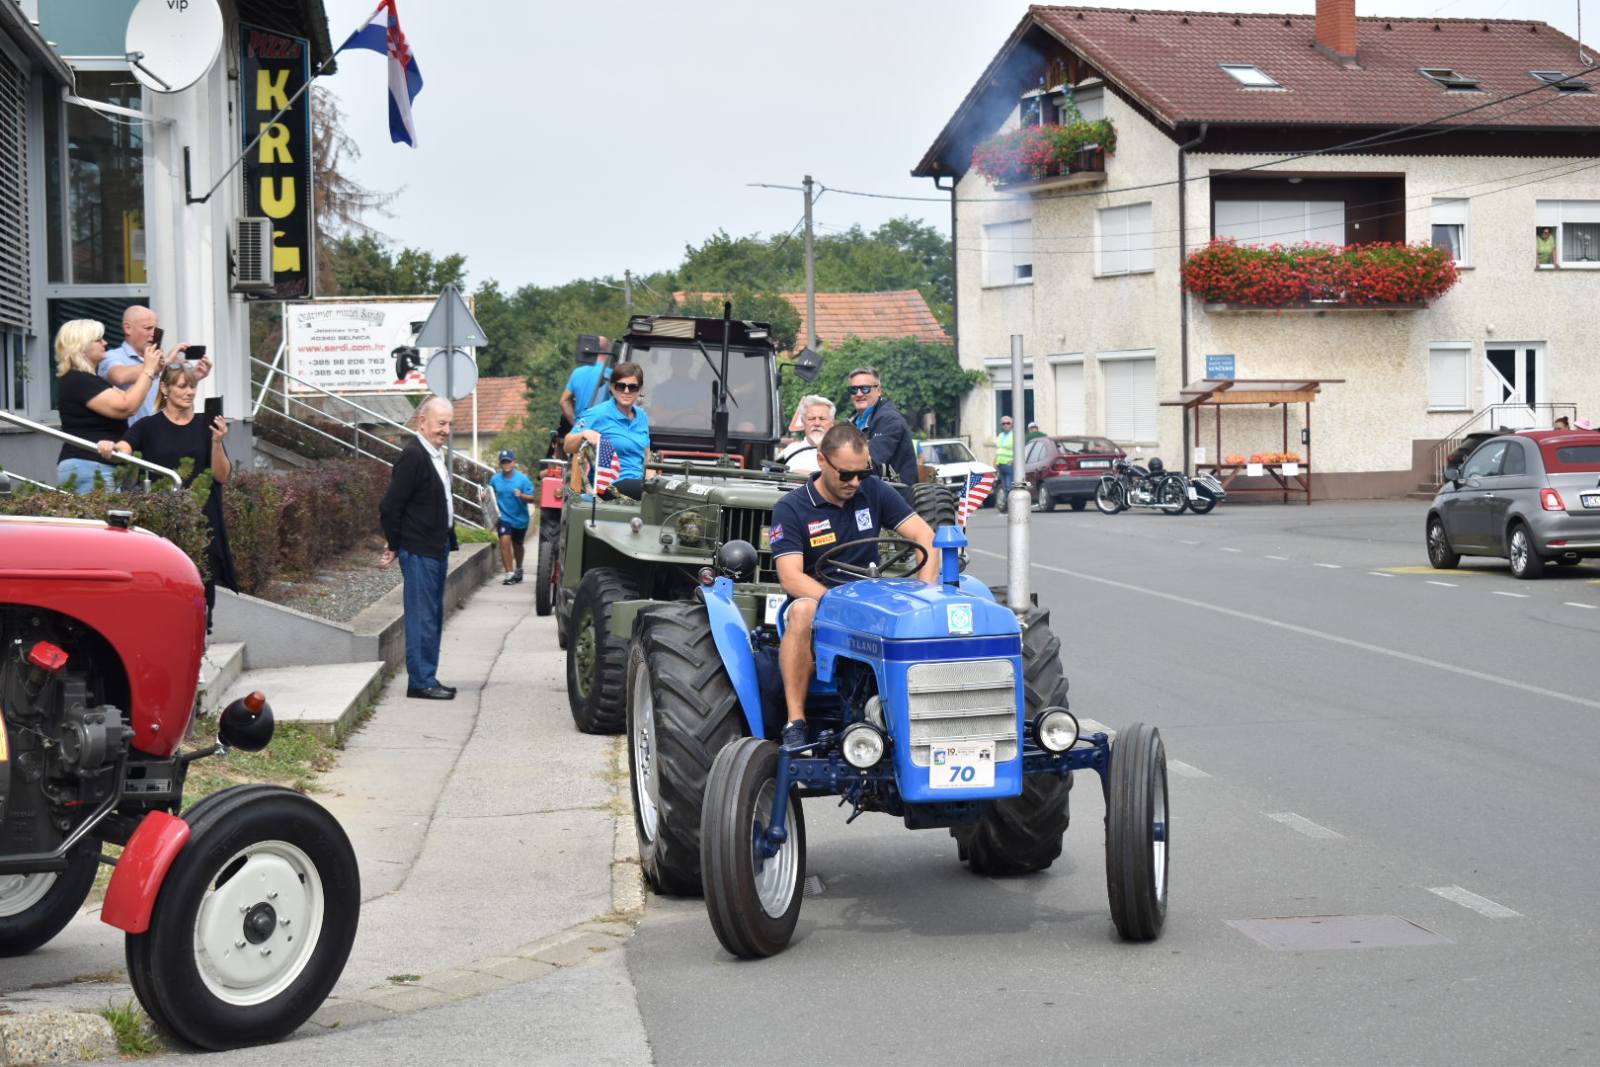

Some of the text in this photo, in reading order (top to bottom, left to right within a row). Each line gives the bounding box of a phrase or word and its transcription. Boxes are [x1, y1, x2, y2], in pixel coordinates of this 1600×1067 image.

[167, 0, 188, 13] vip
[298, 344, 385, 353] www.sardi.com.hr
[310, 369, 332, 377] +385
[946, 747, 958, 757] 19.
[948, 765, 976, 783] 70
